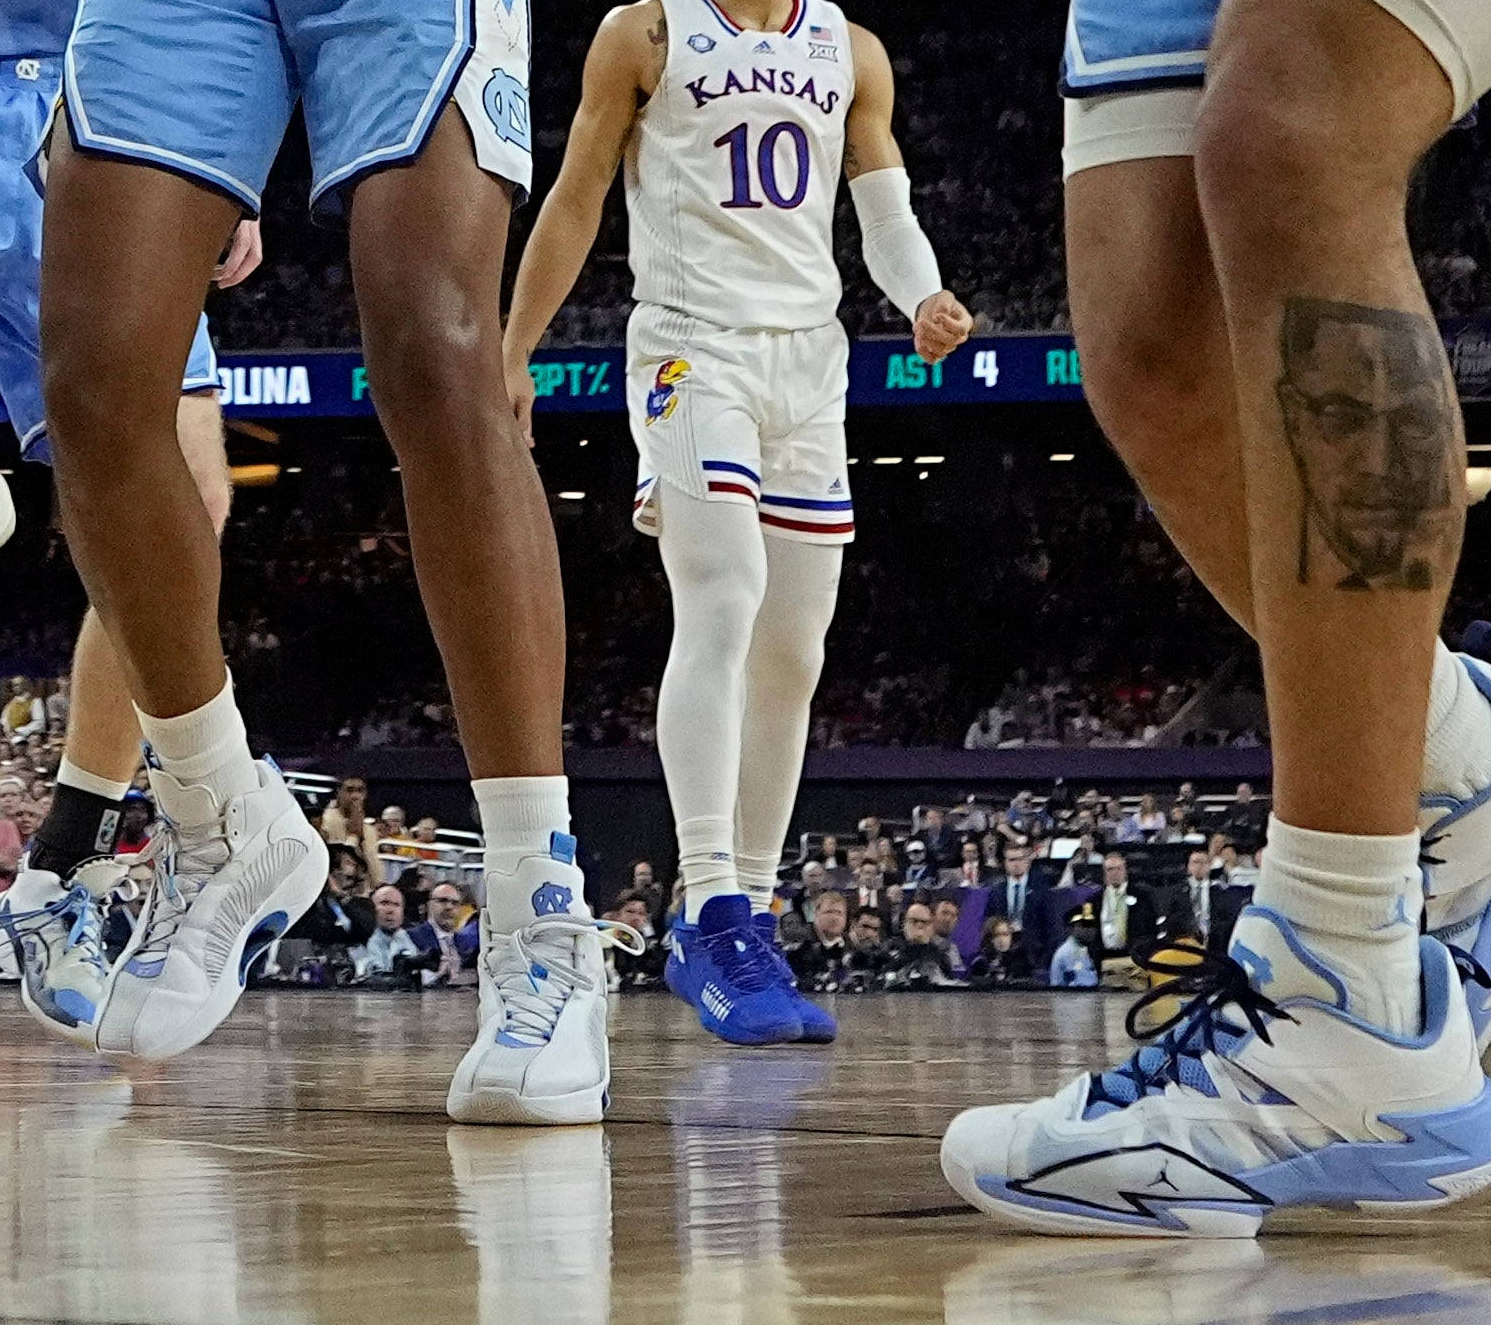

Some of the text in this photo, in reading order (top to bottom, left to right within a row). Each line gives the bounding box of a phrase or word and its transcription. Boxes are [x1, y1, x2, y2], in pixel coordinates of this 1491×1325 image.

[684, 67, 841, 116] KANSAS
[712, 120, 812, 211] 10
[885, 352, 944, 390] AST
[972, 349, 1000, 388] 4
